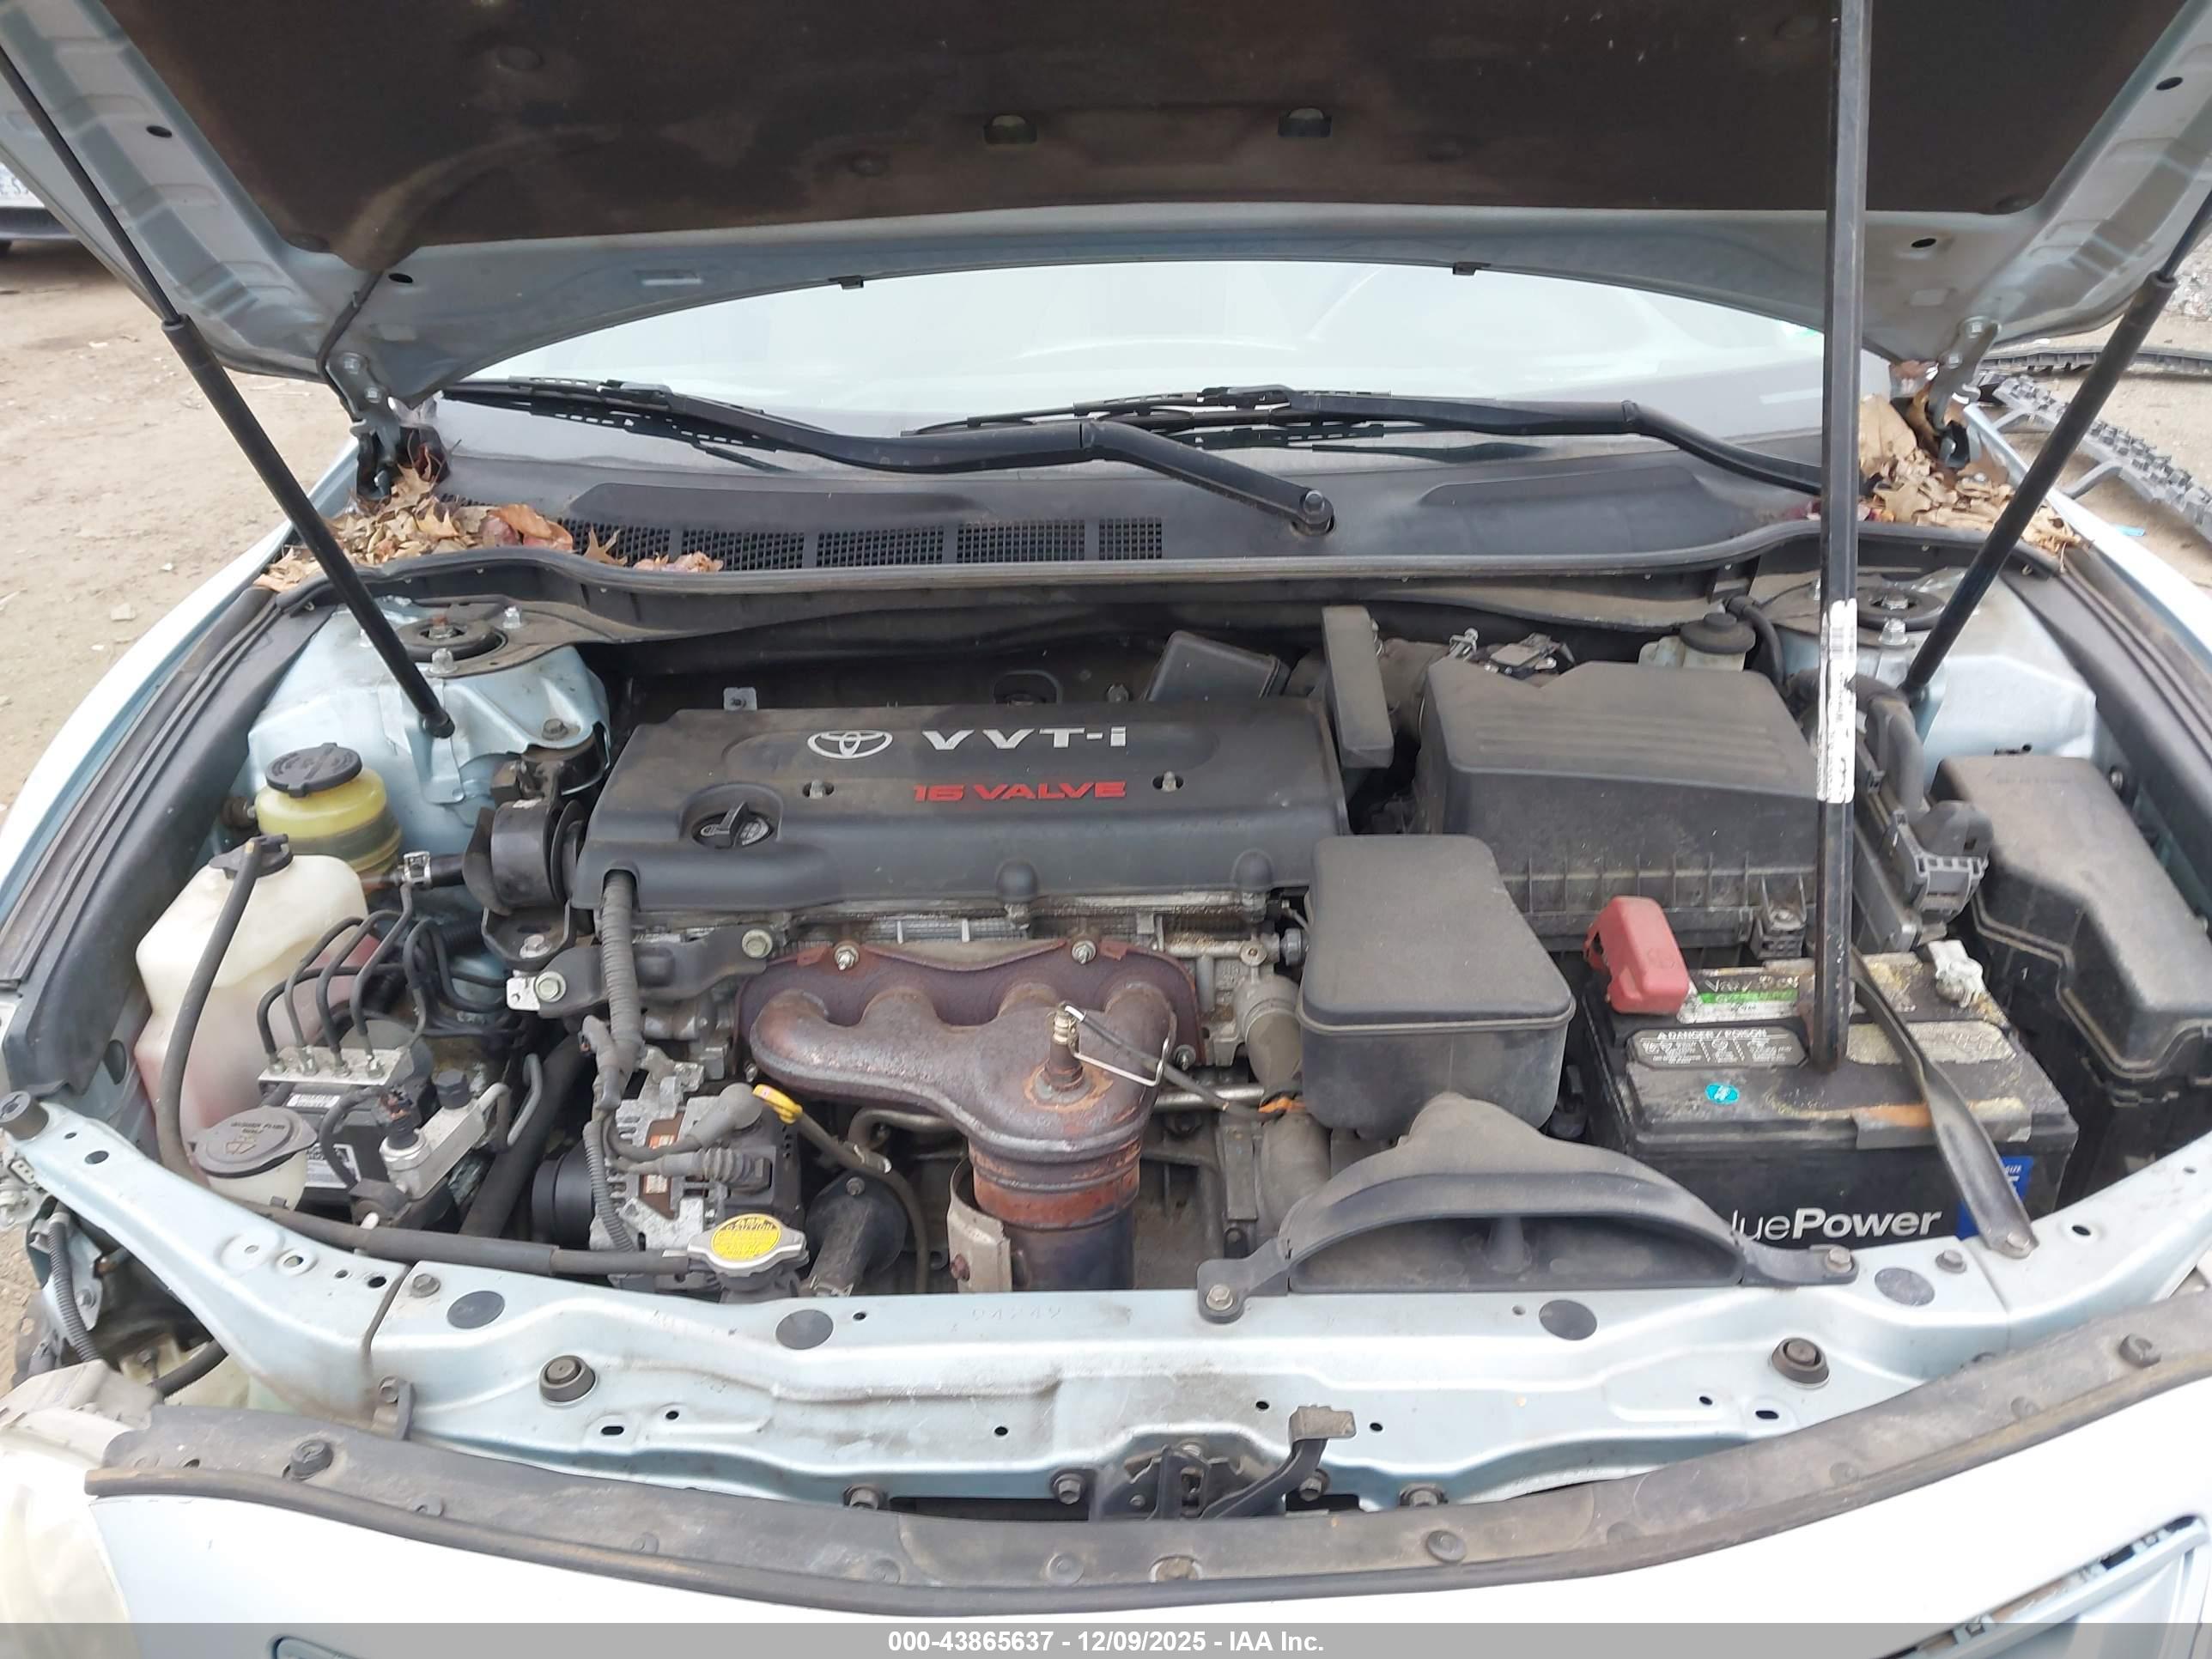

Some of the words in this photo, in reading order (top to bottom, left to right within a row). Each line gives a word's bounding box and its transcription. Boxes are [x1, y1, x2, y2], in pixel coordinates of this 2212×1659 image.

[921, 726, 1127, 750] VVT-i
[913, 783, 965, 802] 16
[972, 781, 1127, 801] VALVE
[1732, 1208, 1942, 1241] luePower
